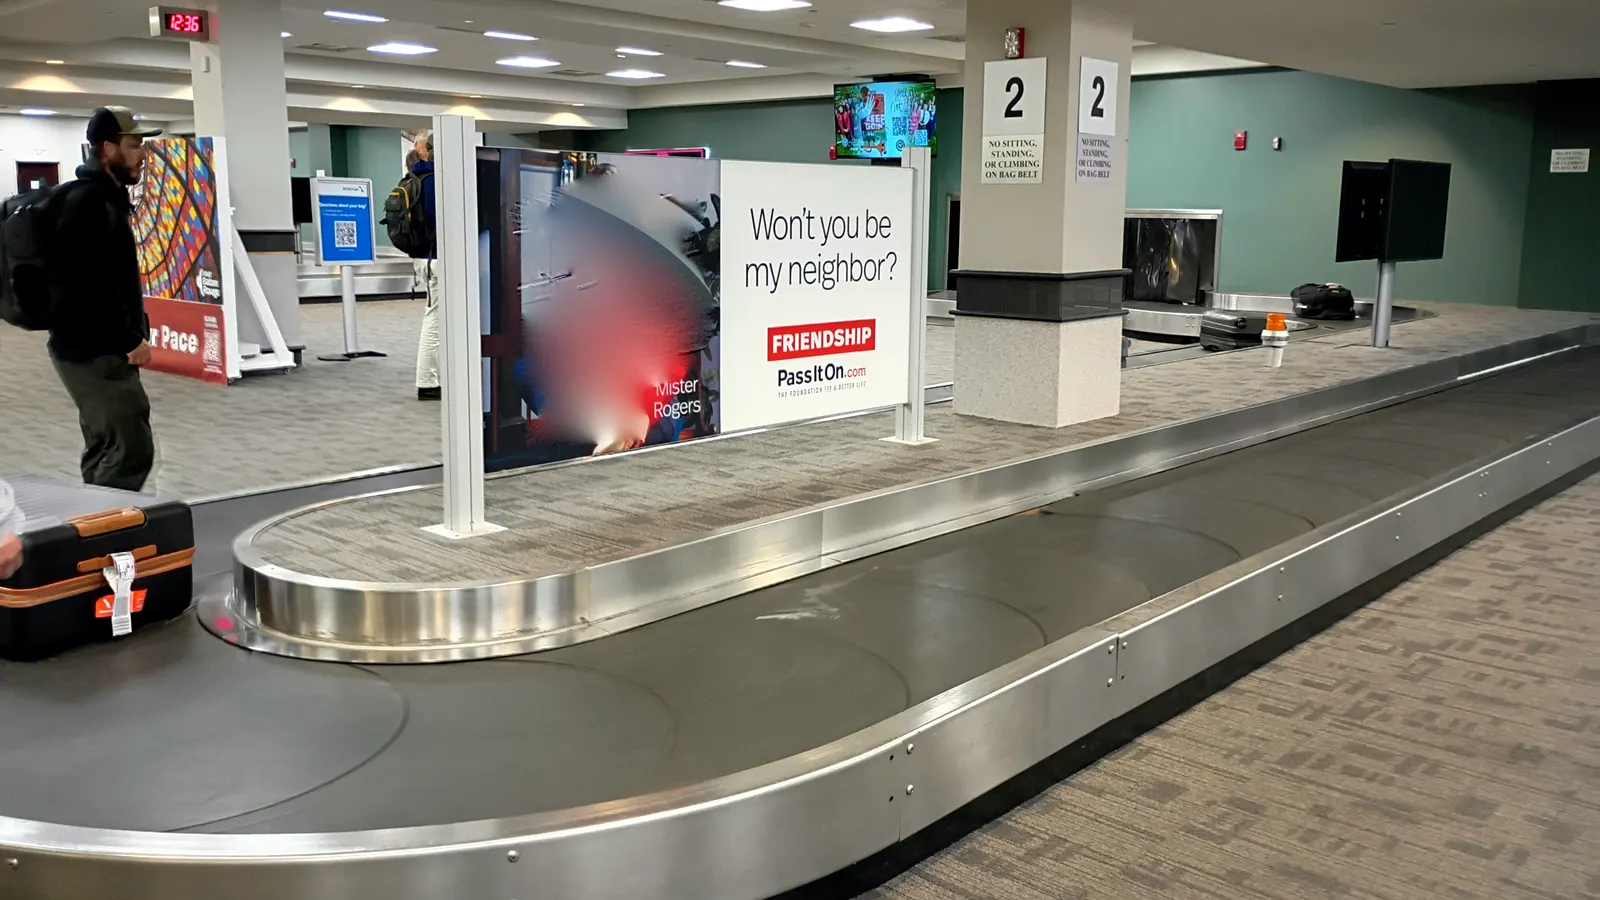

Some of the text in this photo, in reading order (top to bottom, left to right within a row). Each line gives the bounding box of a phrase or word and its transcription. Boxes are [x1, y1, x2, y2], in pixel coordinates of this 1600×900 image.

[170, 14, 200, 32] 12:36
[1004, 76, 1025, 118] 2
[1090, 75, 1105, 118] 2
[989, 139, 1037, 148] NO SITTING,
[1081, 138, 1089, 146] NO
[991, 150, 1034, 158] STANDING,
[998, 160, 1040, 168] CLIMBING
[1078, 159, 1112, 168] OR CLIMBING
[1017, 170, 1039, 178] BELT
[1078, 170, 1110, 178] ON BAG BELT
[750, 207, 892, 246] Won't you be
[745, 251, 898, 294] my neighbor?
[160, 324, 200, 355] Pace
[772, 327, 872, 354] FRIENDSHIP
[655, 378, 699, 397] Mister
[653, 400, 701, 419] Rogers
